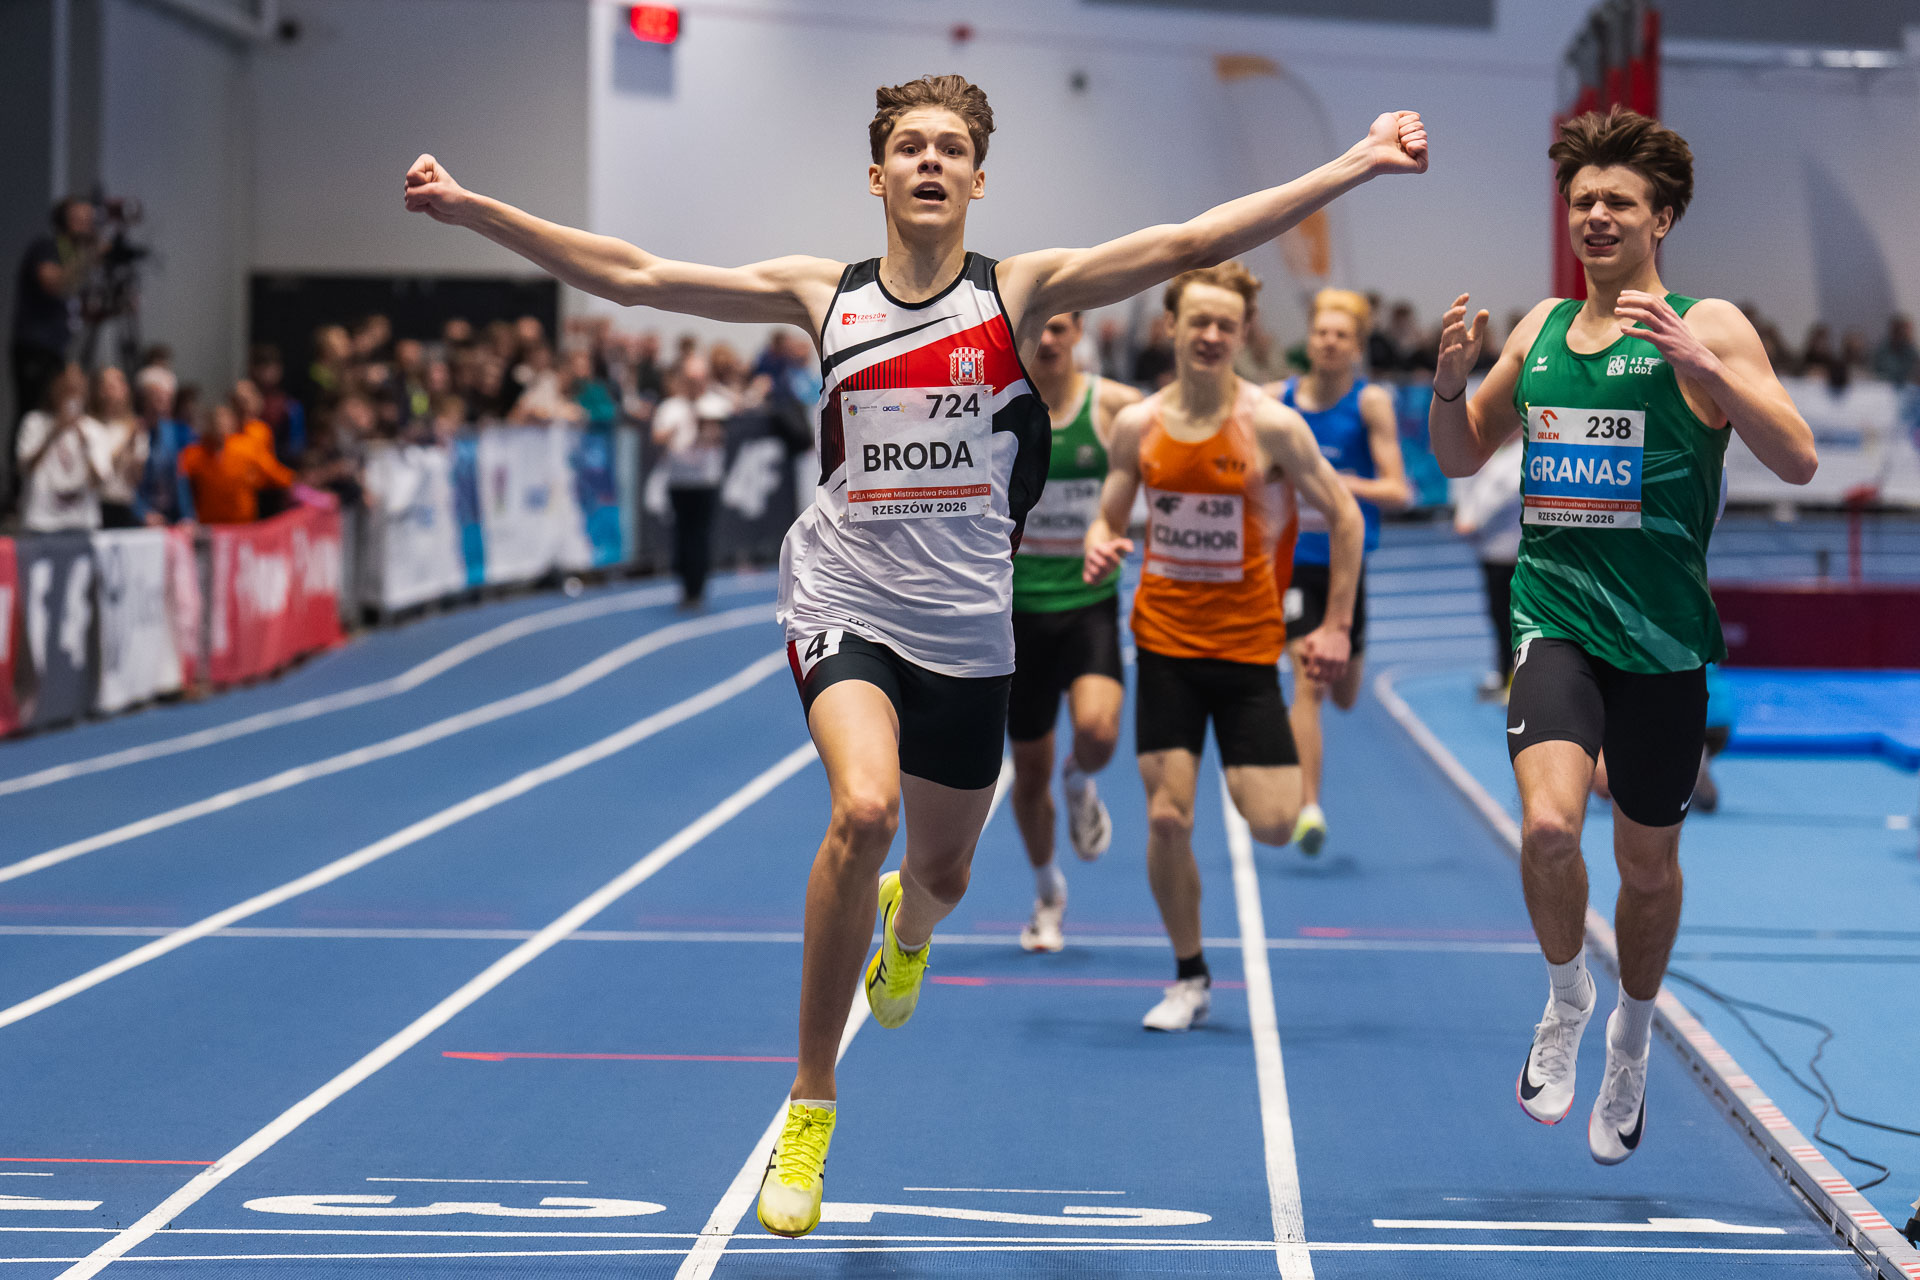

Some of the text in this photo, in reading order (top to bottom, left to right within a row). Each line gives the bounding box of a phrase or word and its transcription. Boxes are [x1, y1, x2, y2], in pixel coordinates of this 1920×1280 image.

[926, 393, 981, 419] 724
[1537, 431, 1560, 441] ORLEN
[1586, 416, 1632, 440] 238
[863, 441, 974, 472] BRODA
[1530, 455, 1633, 486] GRANAS
[866, 491, 892, 499] Halowe
[893, 489, 937, 498] Mistrzostwa
[938, 487, 959, 496] Polski
[872, 501, 967, 516] RZESZÓW 2026
[1196, 499, 1235, 518] 438
[1551, 500, 1587, 509] Mistrzostwa
[1587, 502, 1607, 510] Polski
[1624, 503, 1637, 511] U20
[1538, 510, 1615, 524] RZESZÓW 2026
[804, 631, 829, 662] 4
